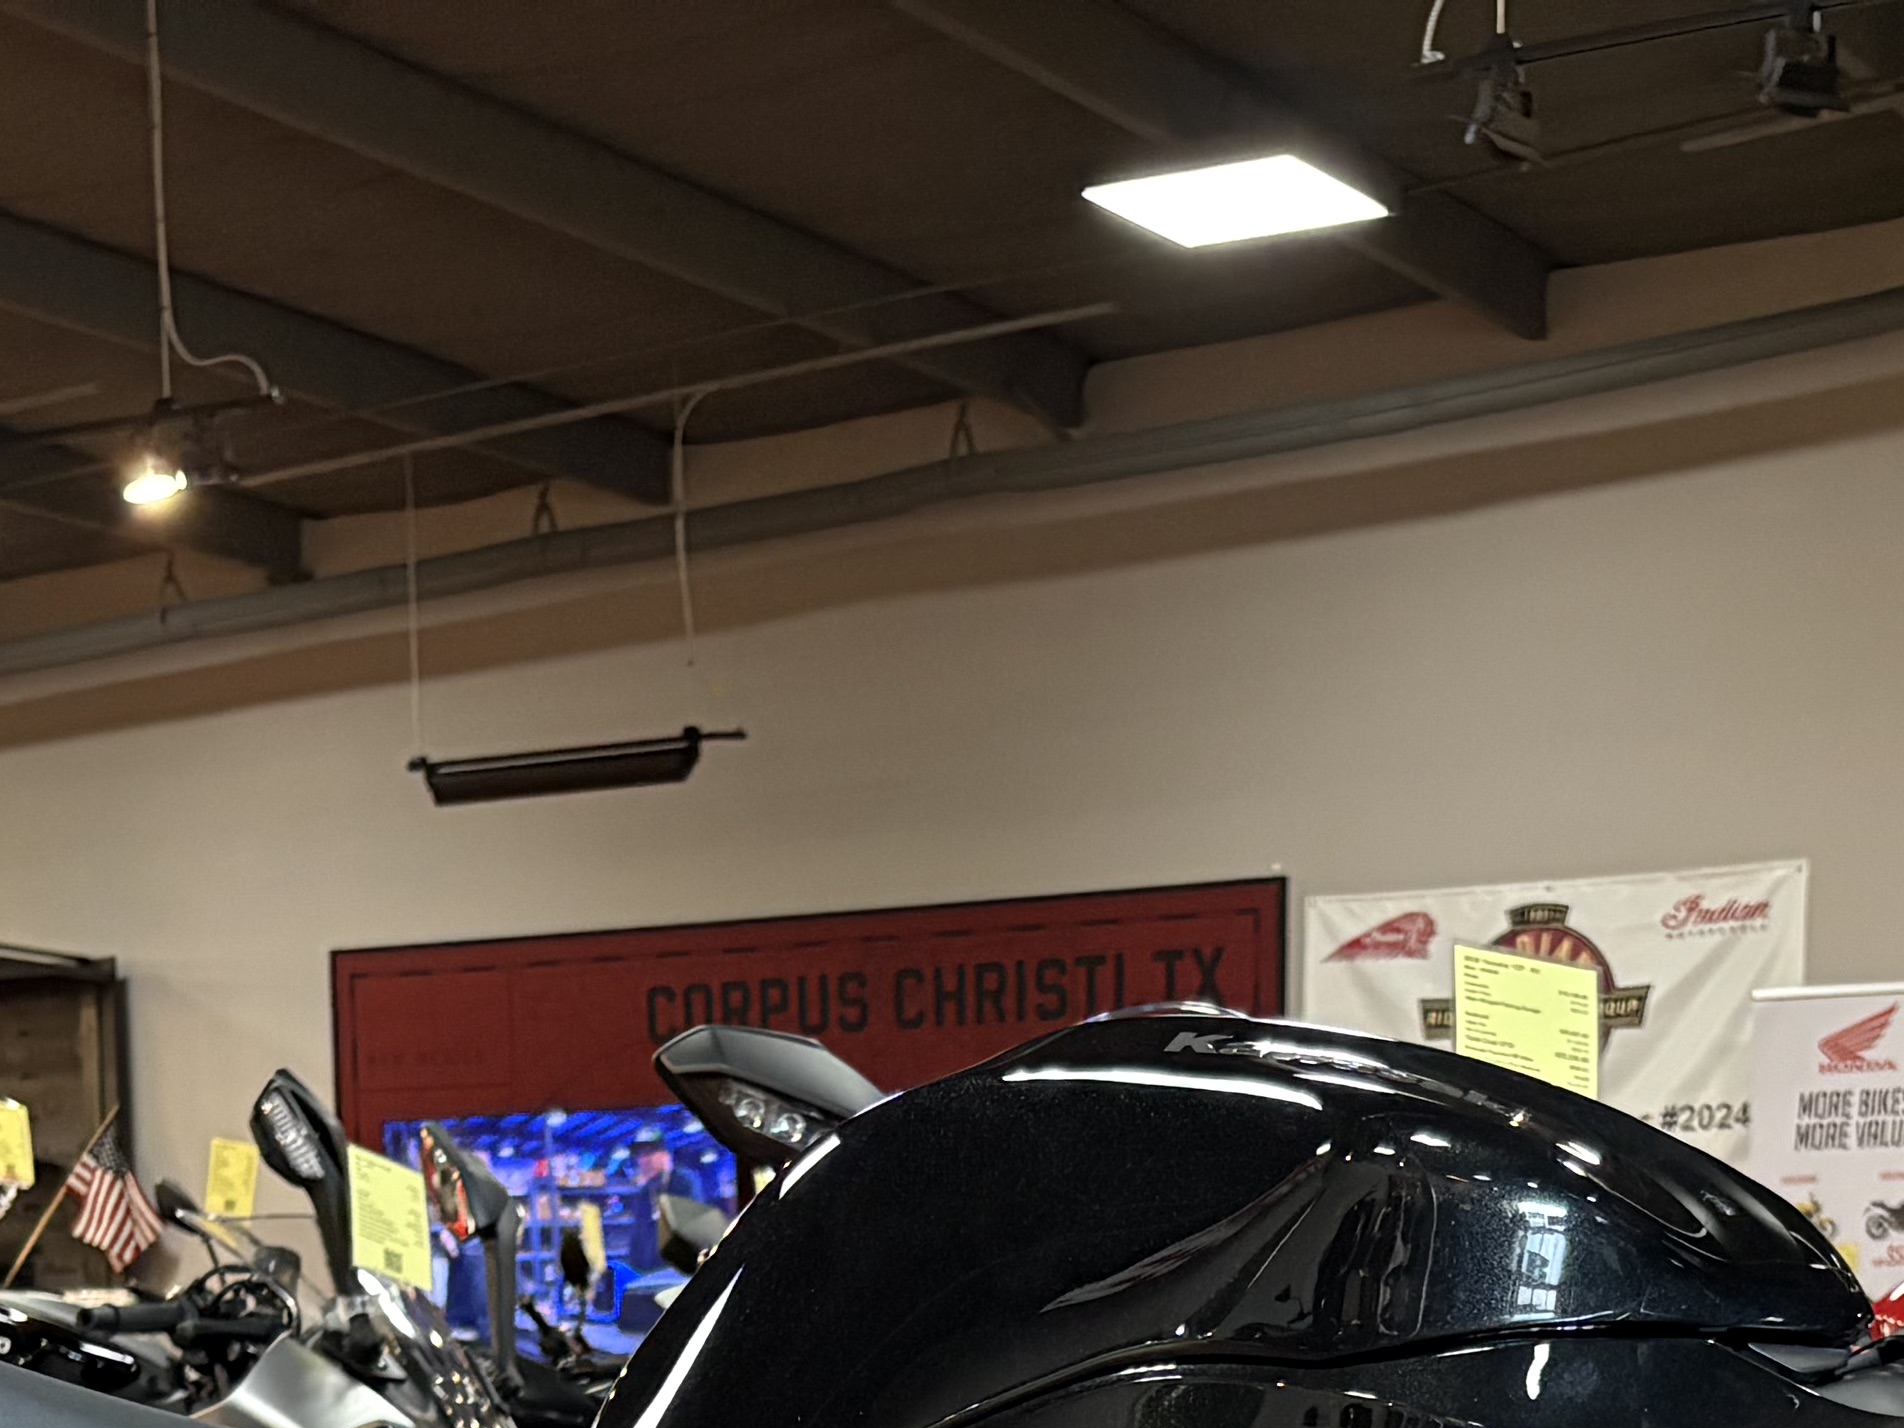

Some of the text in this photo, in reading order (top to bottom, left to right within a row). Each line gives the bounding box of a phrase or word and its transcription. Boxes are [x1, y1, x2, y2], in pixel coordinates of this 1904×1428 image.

[1661, 894, 1771, 931] Indian
[645, 946, 1227, 1045] CORPUS CHRISTI TX
[1660, 1102, 1750, 1132] #2024
[1798, 1090, 1854, 1121] MORE
[1795, 1120, 1851, 1151] MORE
